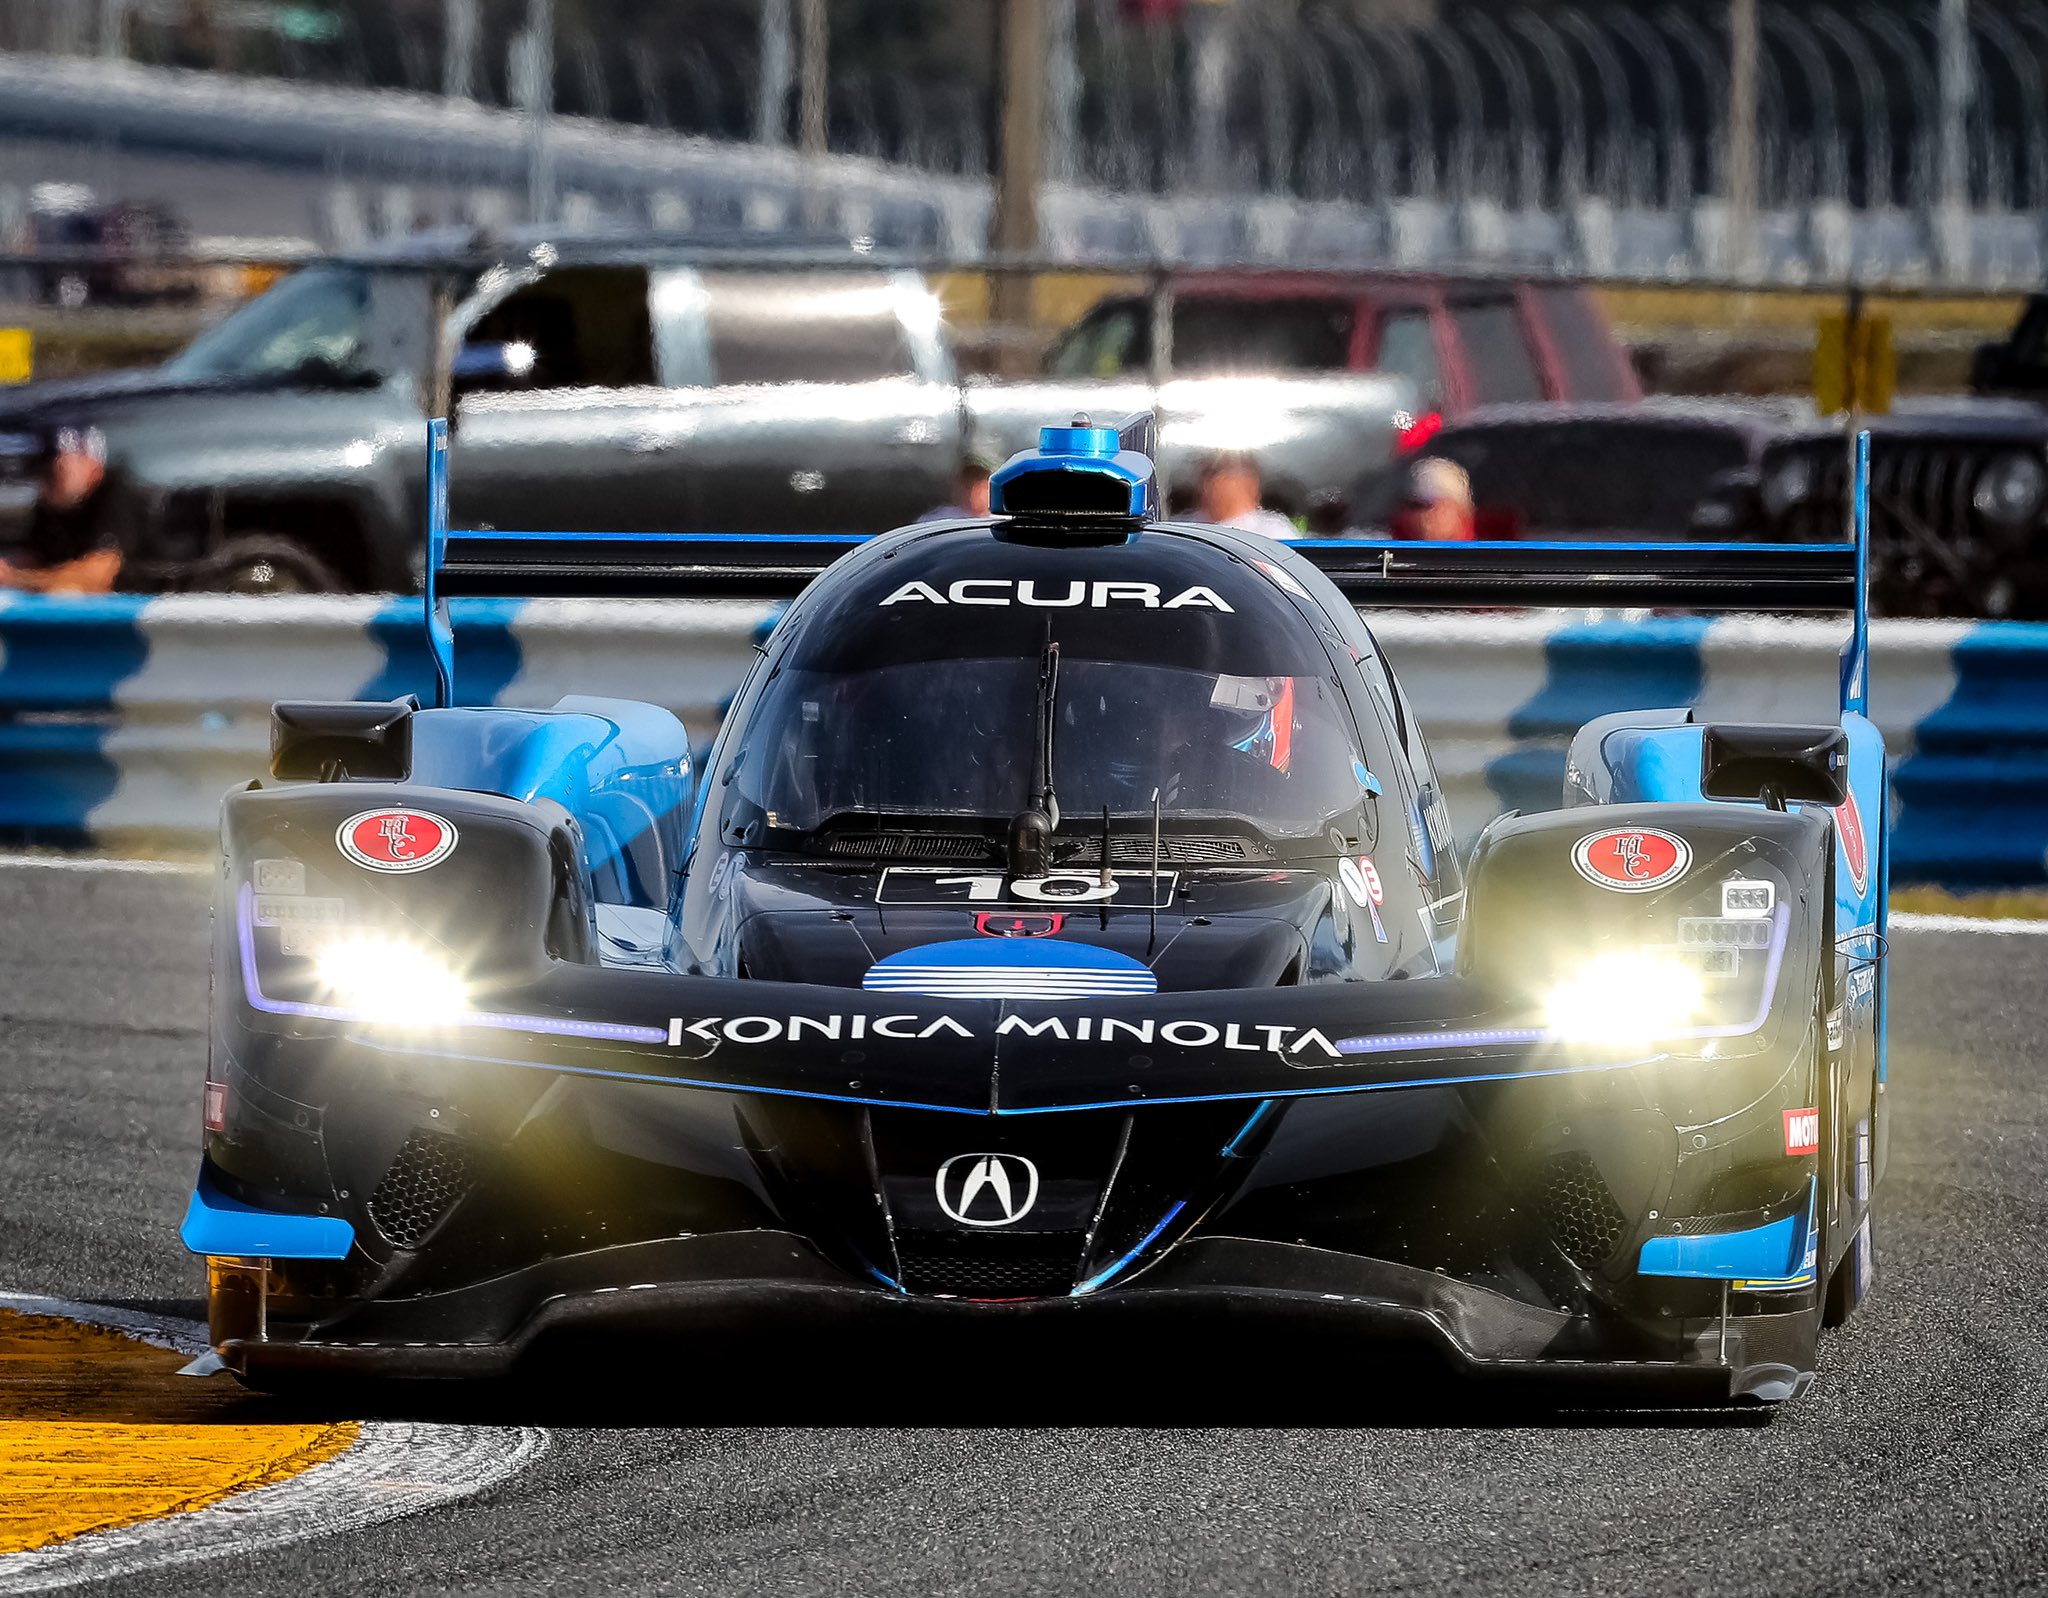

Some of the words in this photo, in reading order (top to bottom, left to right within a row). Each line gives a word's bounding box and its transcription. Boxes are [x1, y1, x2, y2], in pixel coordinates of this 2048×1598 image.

[879, 580, 1236, 613] ACURA
[934, 875, 1120, 901] 10
[1364, 866, 1380, 895] E
[668, 1014, 975, 1046] KONICA
[995, 1014, 1343, 1058] MINOLTA
